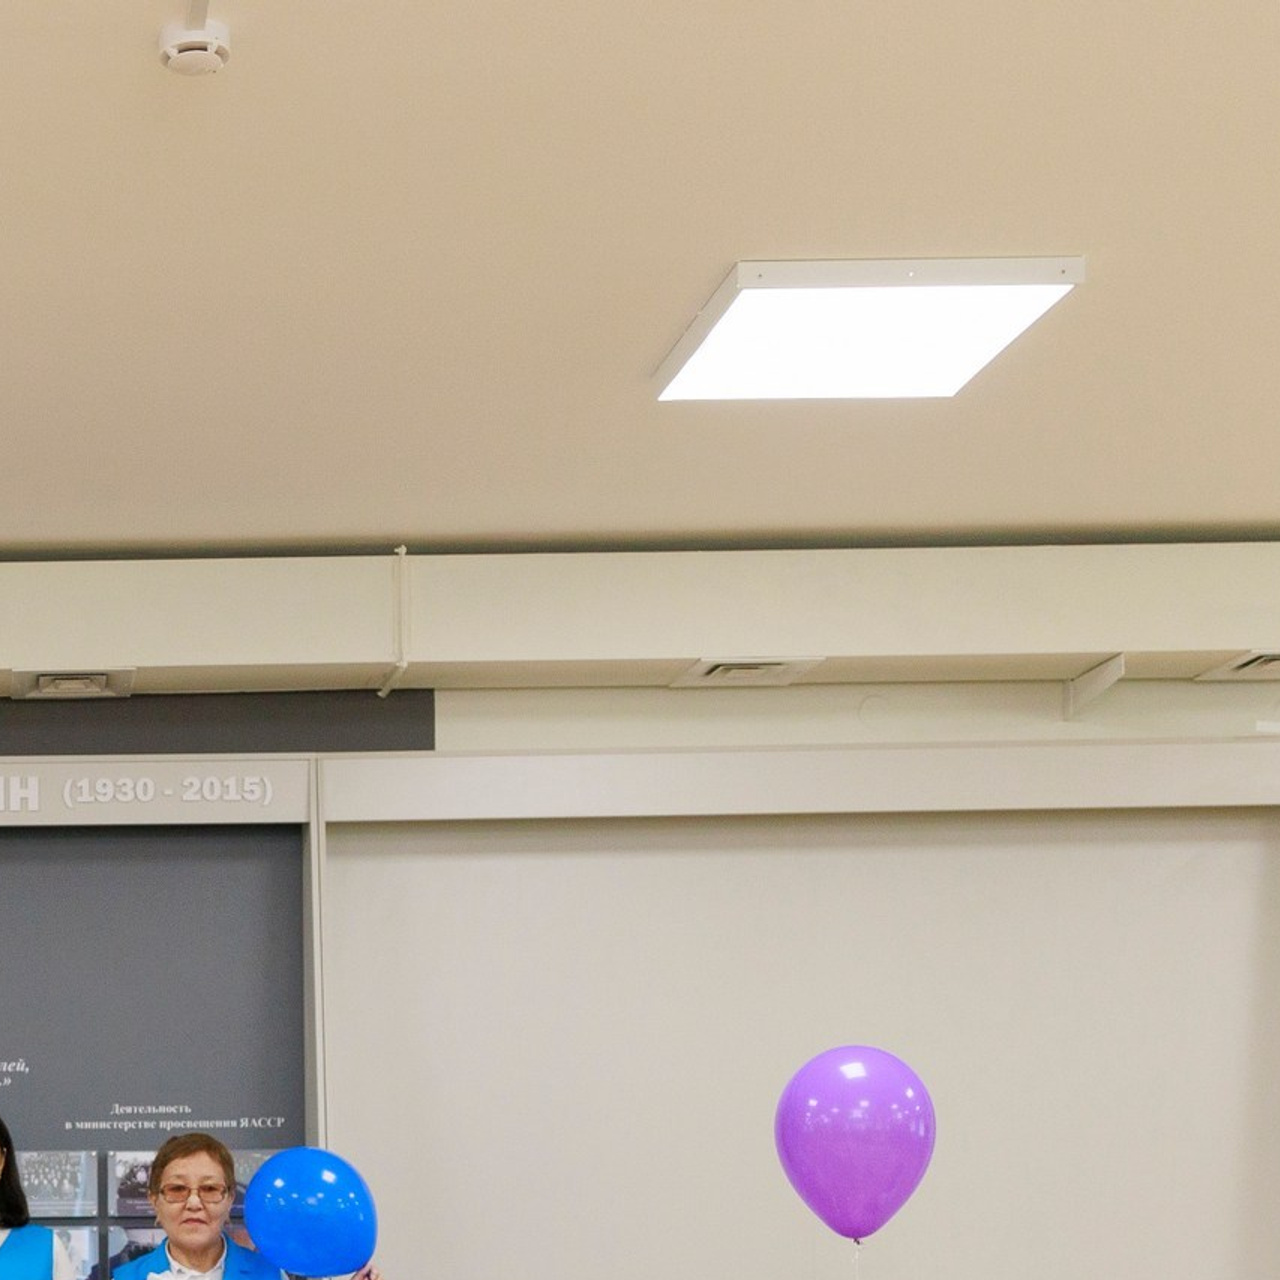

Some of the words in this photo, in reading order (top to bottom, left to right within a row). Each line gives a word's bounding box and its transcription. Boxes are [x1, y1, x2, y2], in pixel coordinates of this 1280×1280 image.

[63, 777, 155, 808] (1930
[181, 775, 273, 805] 2015)
[110, 1103, 192, 1115] Деятельность
[75, 1119, 157, 1131] министерстве
[159, 1118, 238, 1131] просвещения
[239, 1117, 285, 1129] ЯАССР
